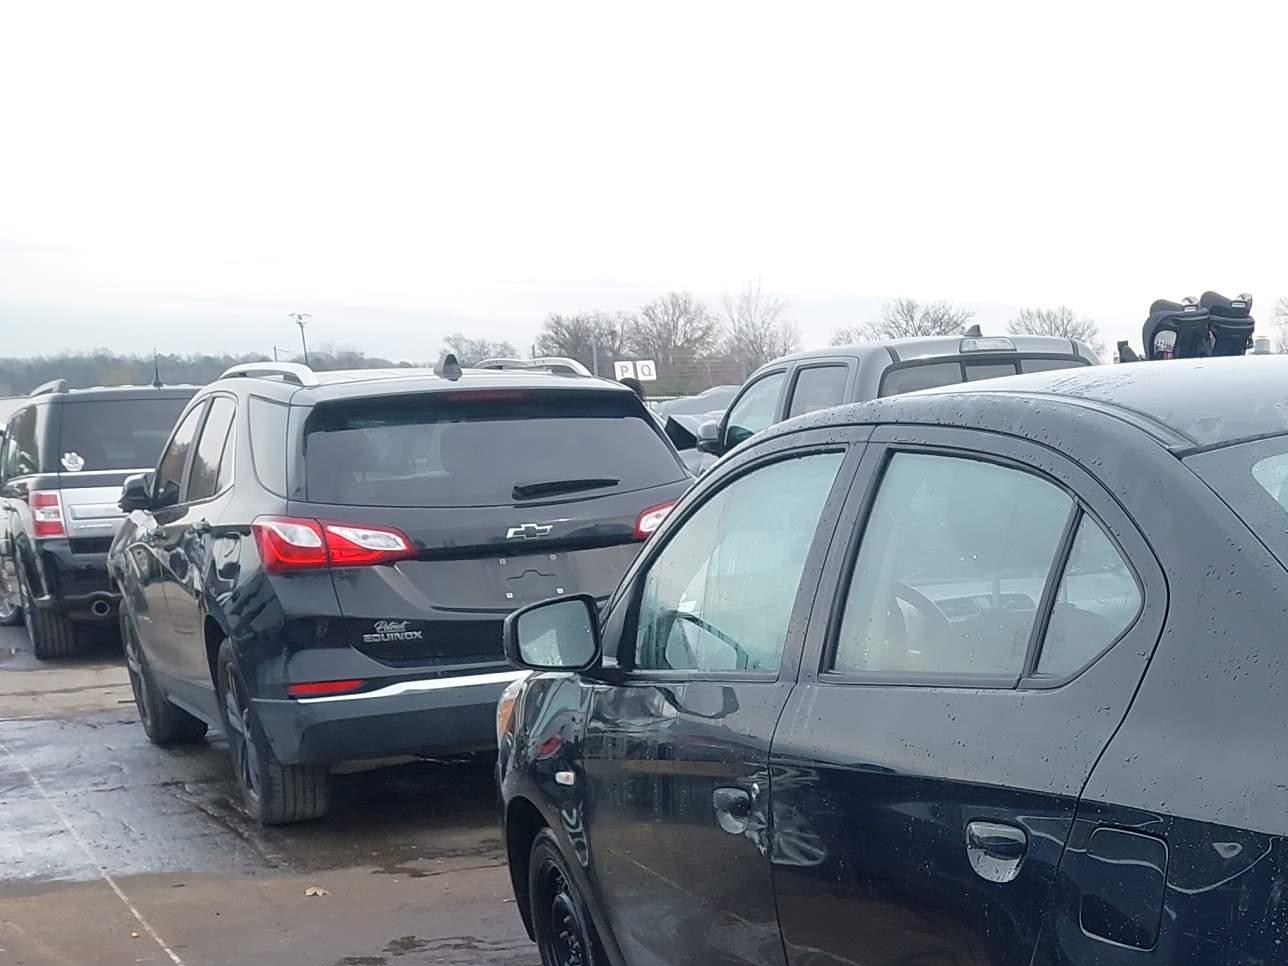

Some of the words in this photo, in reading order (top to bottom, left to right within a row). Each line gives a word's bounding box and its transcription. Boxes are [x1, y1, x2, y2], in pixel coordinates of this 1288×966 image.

[620, 365, 629, 377] P
[640, 364, 653, 377] Q
[362, 629, 424, 643] EQUINOX
